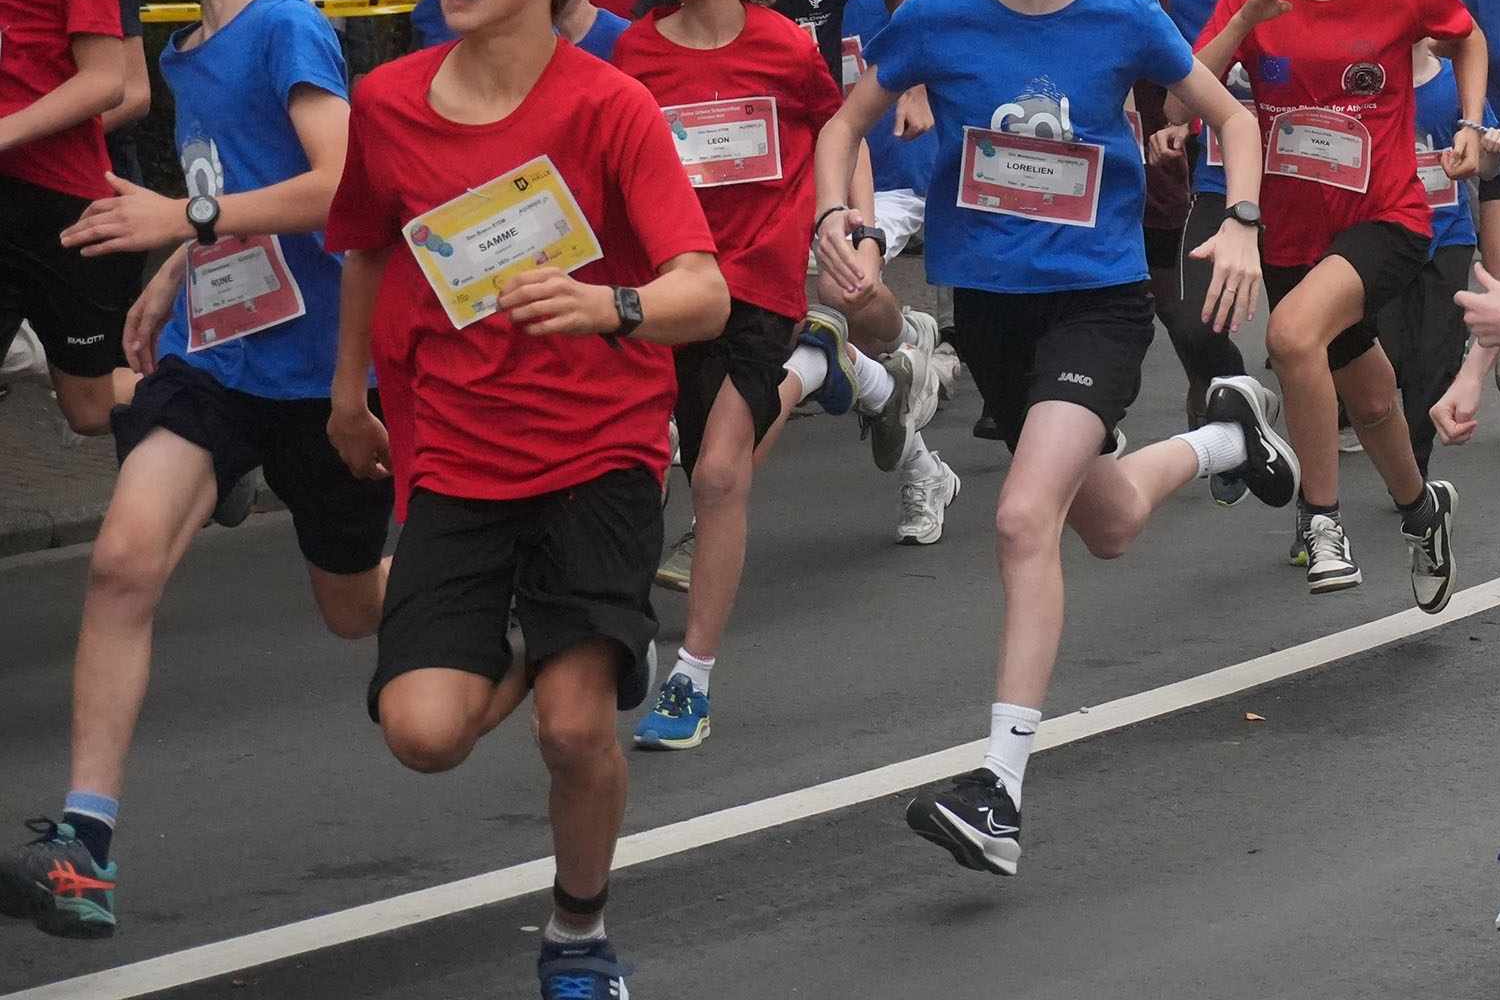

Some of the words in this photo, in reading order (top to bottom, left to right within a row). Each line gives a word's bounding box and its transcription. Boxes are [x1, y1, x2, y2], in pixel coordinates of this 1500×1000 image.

[1332, 104, 1345, 112] for
[706, 136, 730, 145] LEON
[1006, 161, 1054, 176] LORELIEN
[478, 226, 519, 252] SAMME
[1057, 371, 1094, 387] JAKO
